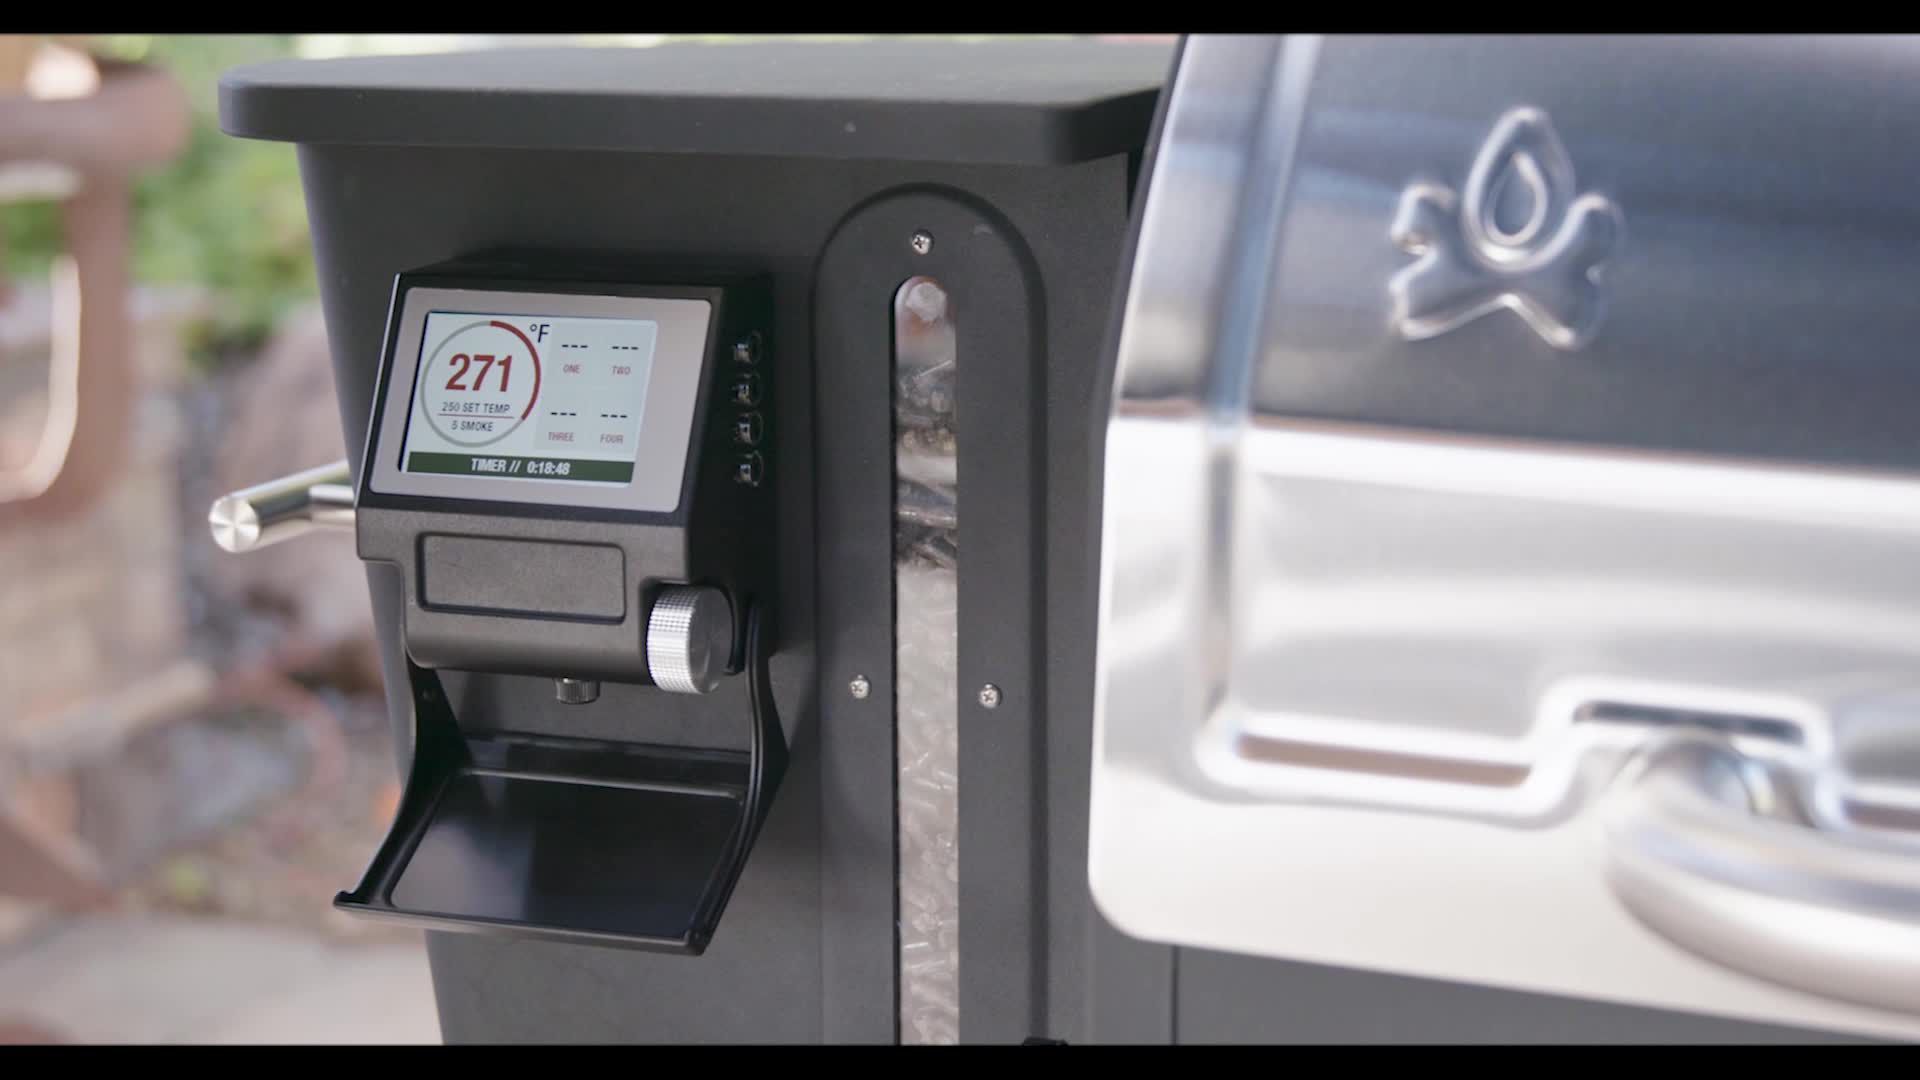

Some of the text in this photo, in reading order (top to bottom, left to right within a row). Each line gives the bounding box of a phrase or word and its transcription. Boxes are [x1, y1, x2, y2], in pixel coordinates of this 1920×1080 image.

[445, 353, 513, 392] 271
[562, 364, 582, 374] ONE
[611, 366, 632, 376] TWO
[441, 401, 511, 414] 250 SET TEMP
[451, 420, 494, 432] 5 SMOKE
[547, 431, 576, 442] THREE
[600, 433, 624, 444] FOUR
[471, 458, 506, 472] TIMER
